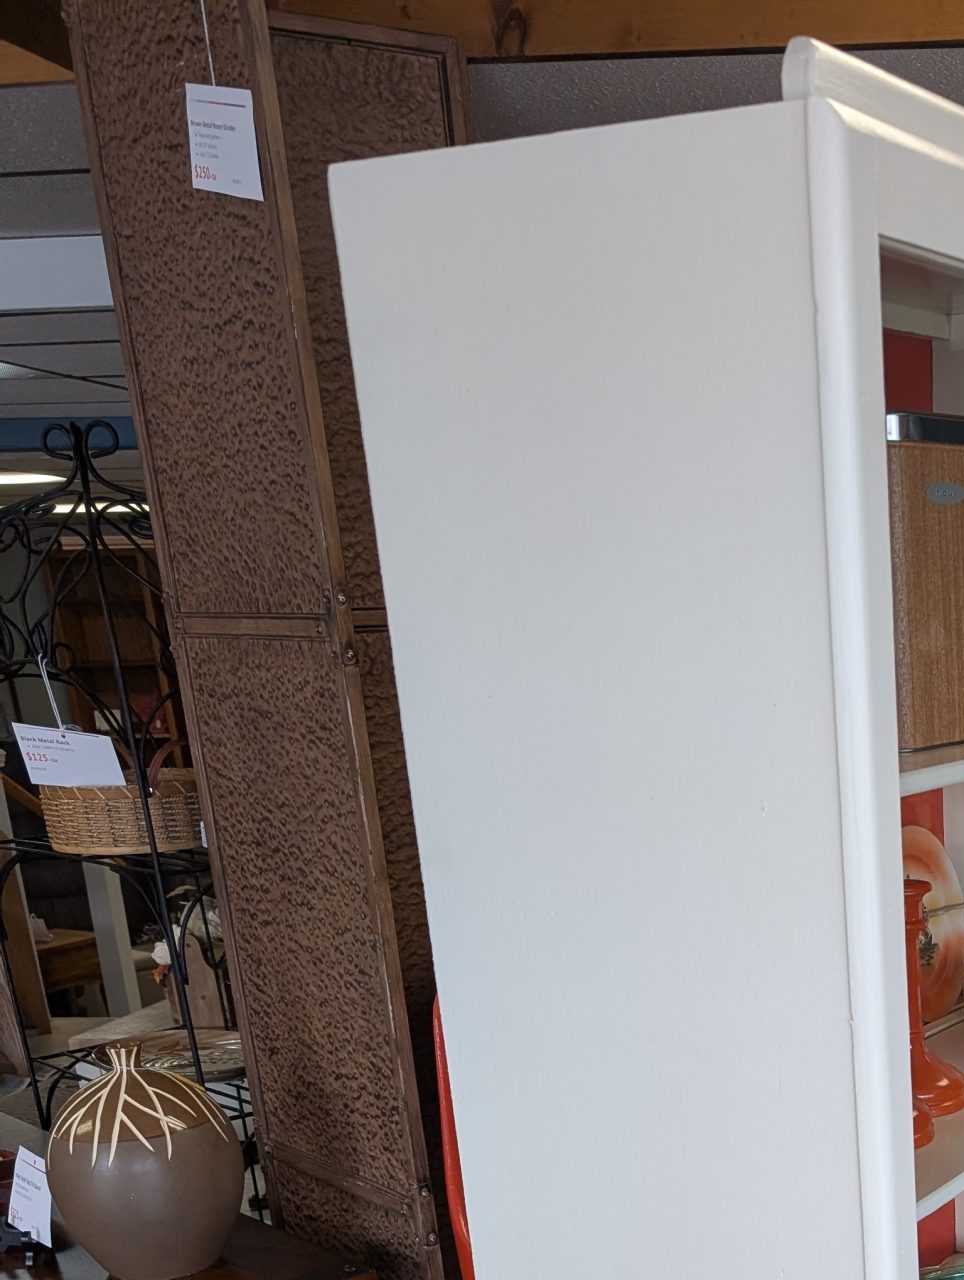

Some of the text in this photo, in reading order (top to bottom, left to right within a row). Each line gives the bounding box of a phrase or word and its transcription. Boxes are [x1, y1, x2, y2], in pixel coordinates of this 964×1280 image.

[194, 164, 210, 180] $250
[20, 735, 37, 743] Black
[38, 737, 55, 745] Metal
[26, 752, 48, 762] $125
